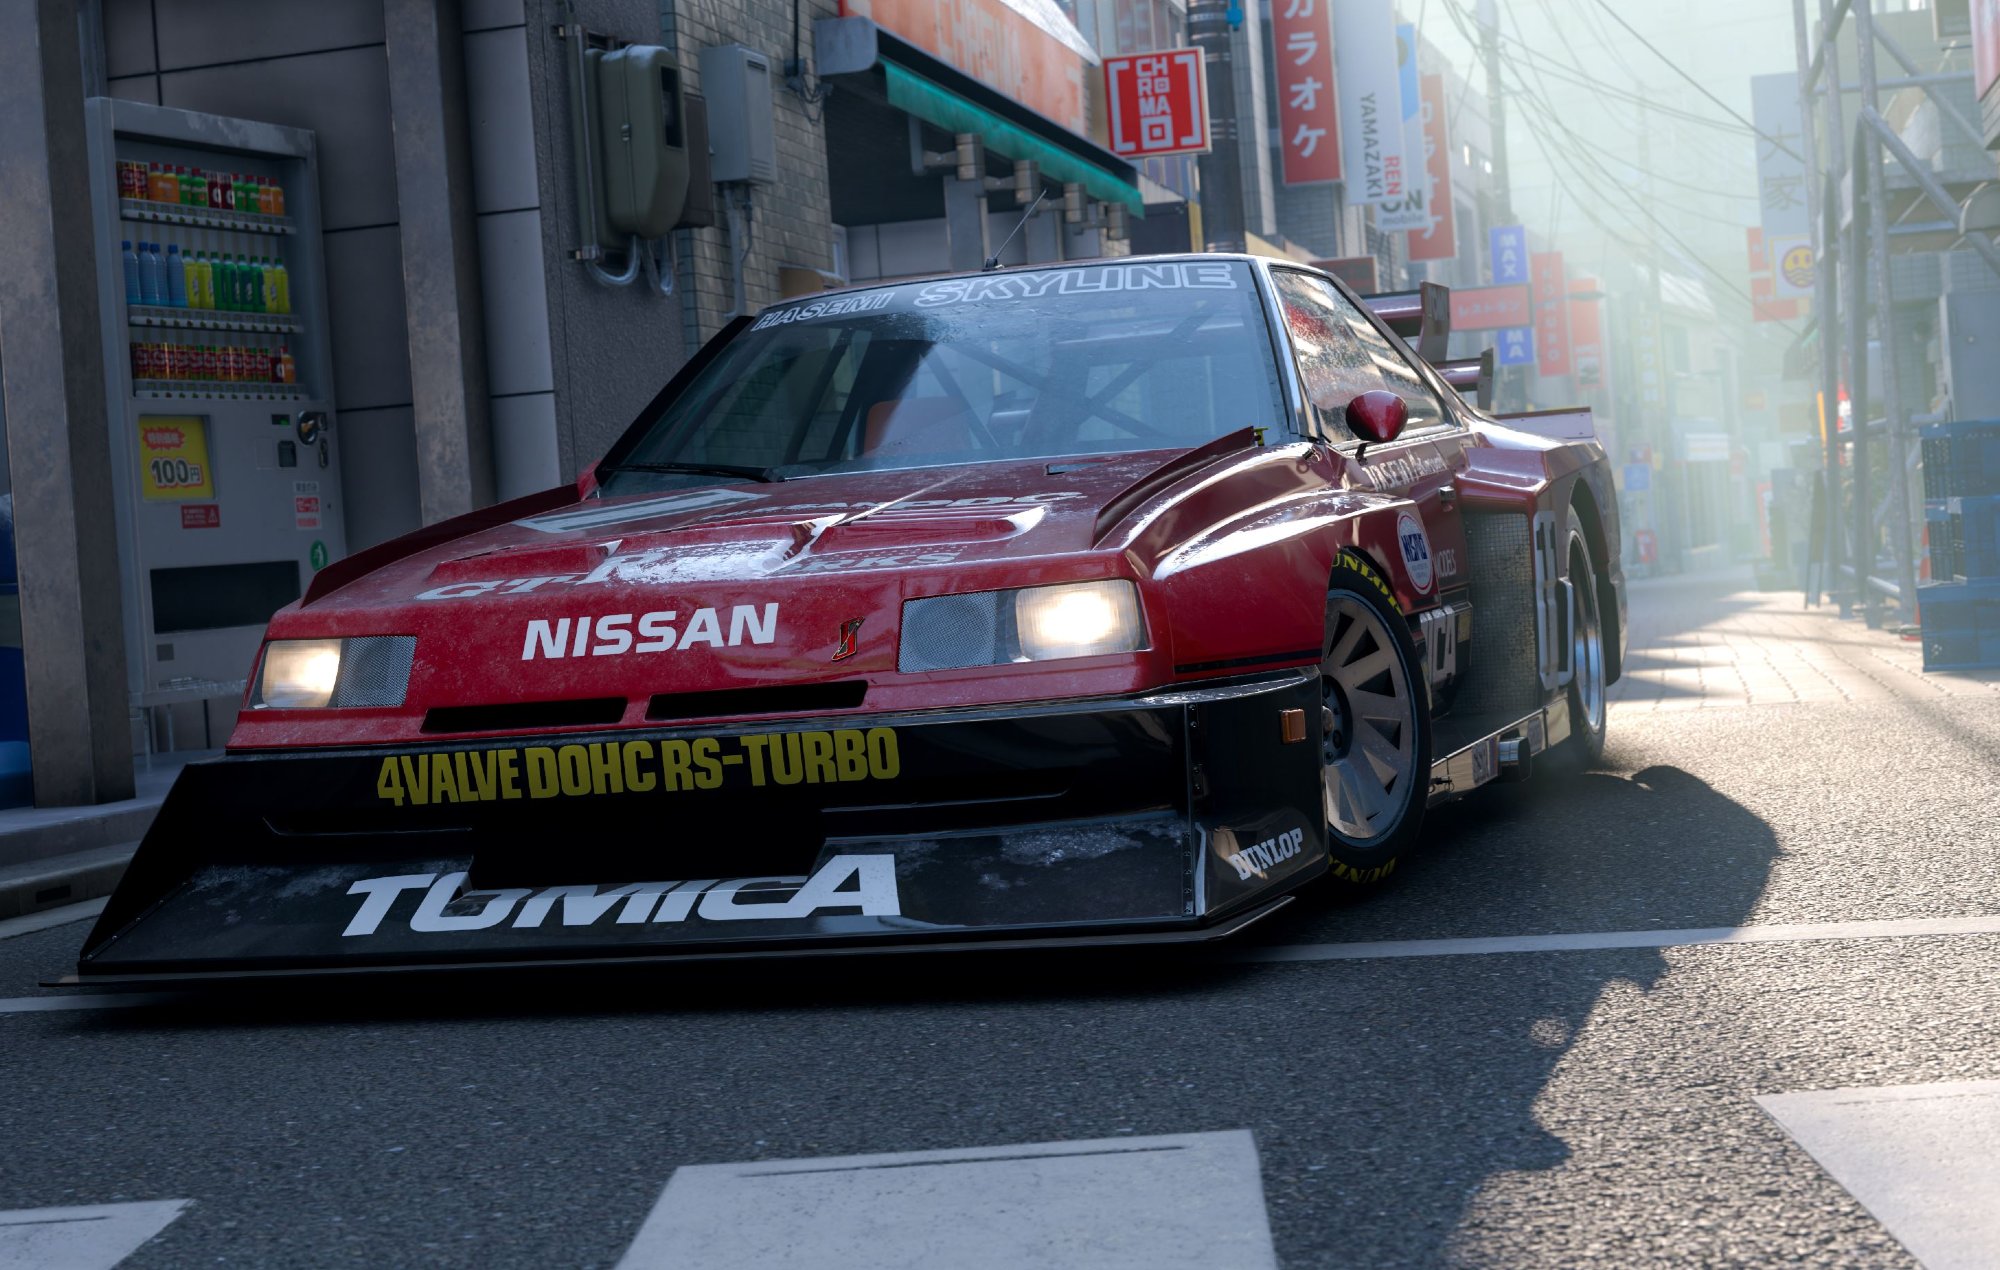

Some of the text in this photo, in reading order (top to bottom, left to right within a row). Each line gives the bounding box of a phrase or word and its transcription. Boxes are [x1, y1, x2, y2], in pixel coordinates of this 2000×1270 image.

[1361, 92, 1382, 199] YAMAZAKI
[1384, 156, 1401, 196] REN
[1502, 233, 1518, 278] MAX
[750, 262, 1238, 332] HASEMI SKYLINE
[522, 602, 779, 660] NISSAN
[377, 728, 901, 806] 4VALVE DOHC RS-TURBO
[1229, 827, 1304, 881] DUNLOP
[342, 853, 901, 938] TOMICA
